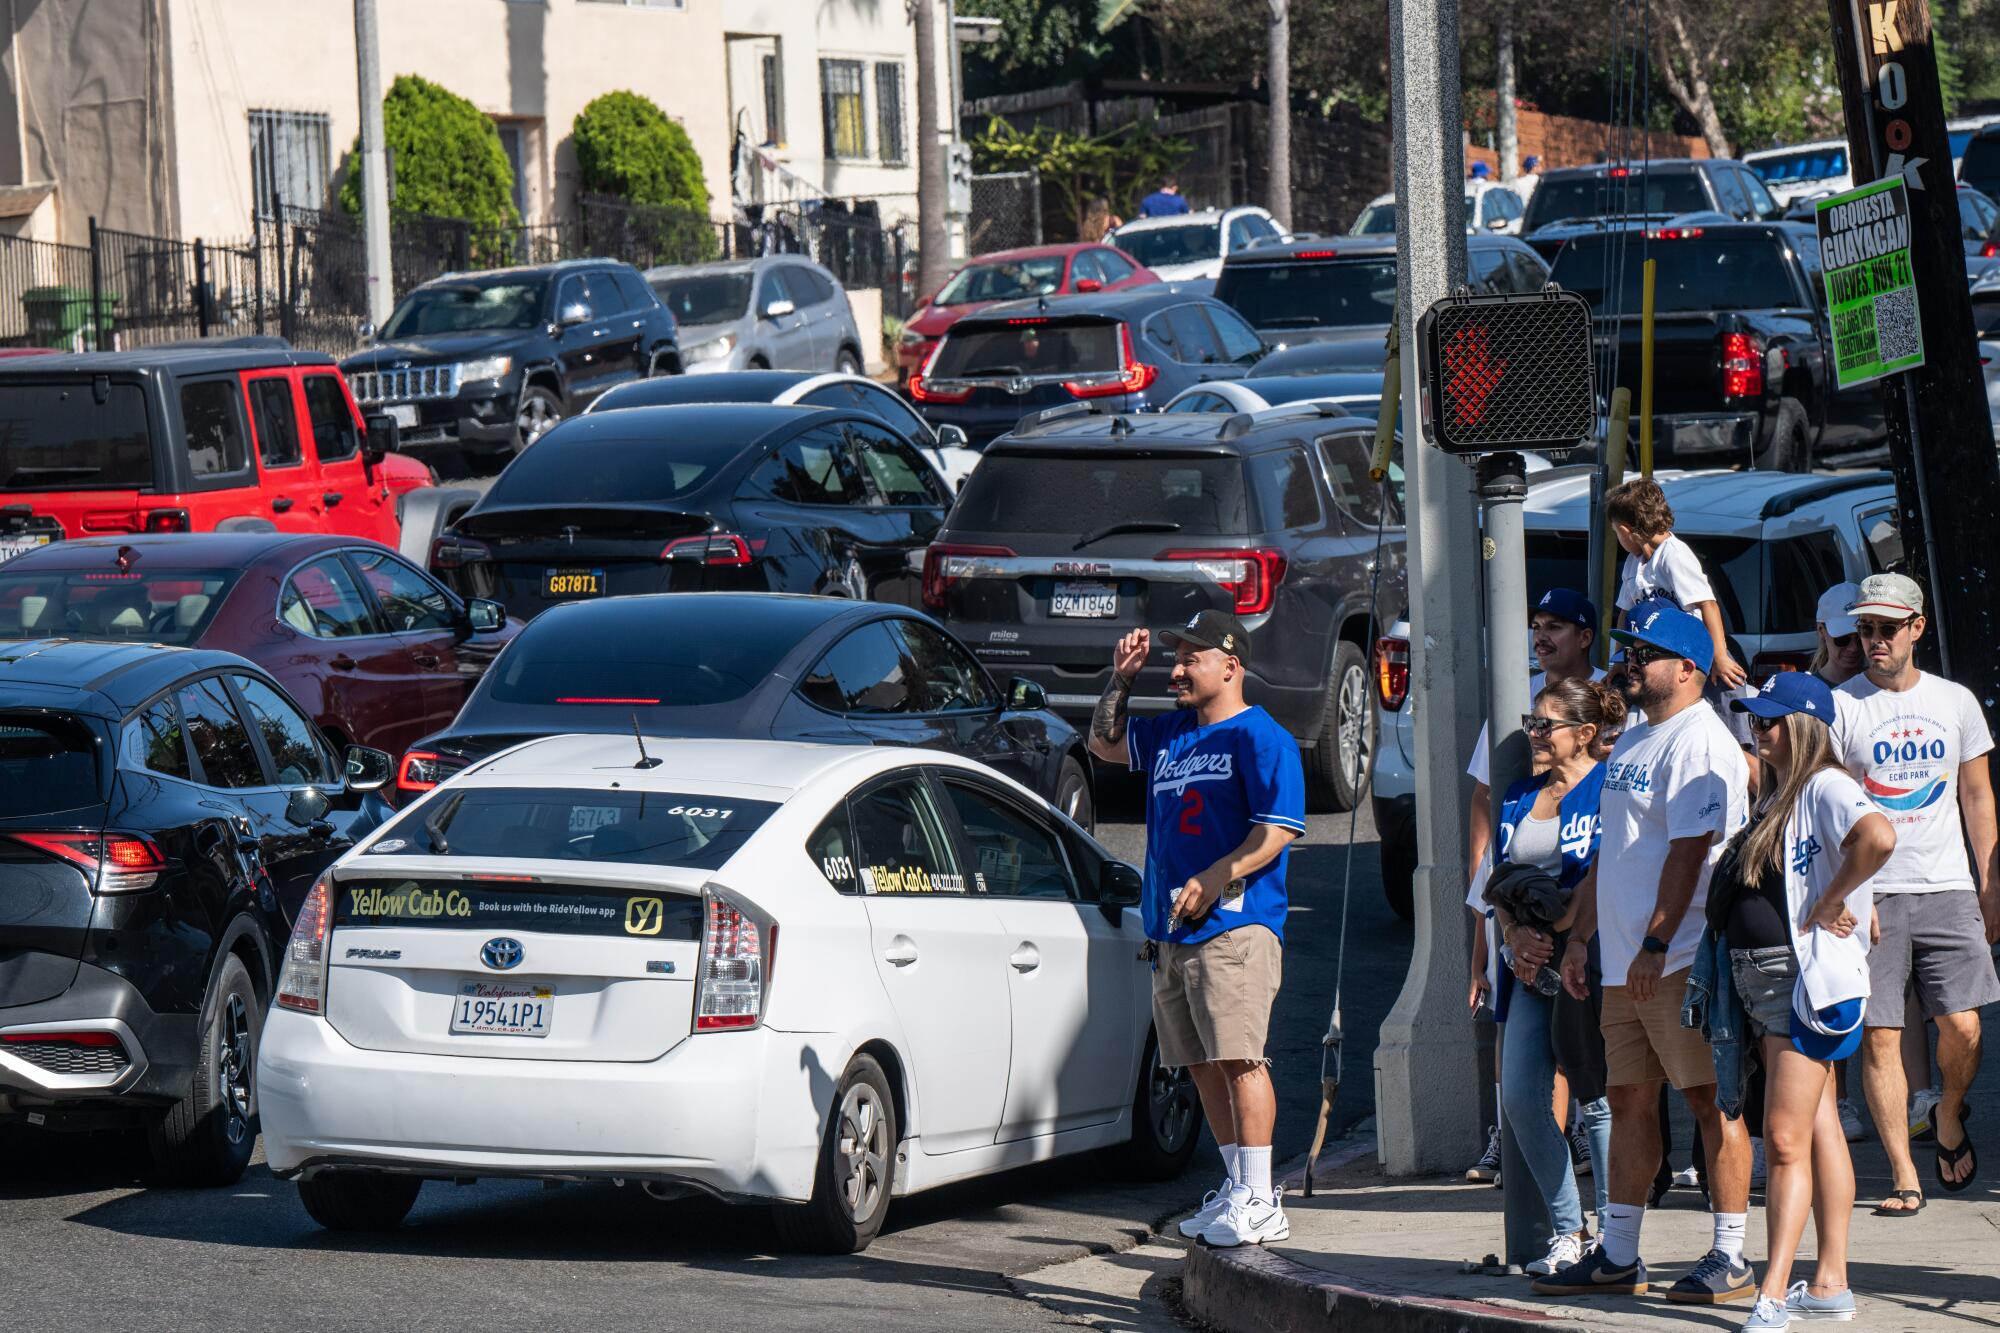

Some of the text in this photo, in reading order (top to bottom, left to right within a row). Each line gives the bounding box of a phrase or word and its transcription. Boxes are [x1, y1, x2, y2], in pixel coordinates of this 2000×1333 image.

[1829, 190, 1896, 233] ORQUESTA
[1822, 214, 1908, 271] GUAYACAN
[1053, 563, 1112, 575] GMC
[1055, 593, 1114, 611] 8ZMT846
[1153, 747, 1233, 797] Dodgers
[1889, 770, 1930, 782] ECHO PARK
[668, 805, 734, 819] 6031
[1179, 788, 1204, 836] 2
[823, 856, 855, 880] 6031
[870, 865, 902, 892] Yellow
[900, 866, 919, 892] Cab
[917, 866, 933, 892] Co.
[351, 889, 471, 918] Yellow Cab Co.
[479, 901, 616, 918] Book us with the RideYellow app
[346, 949, 401, 960] PRIUS
[477, 983, 531, 1000] California
[460, 1000, 543, 1028] 19541P1
